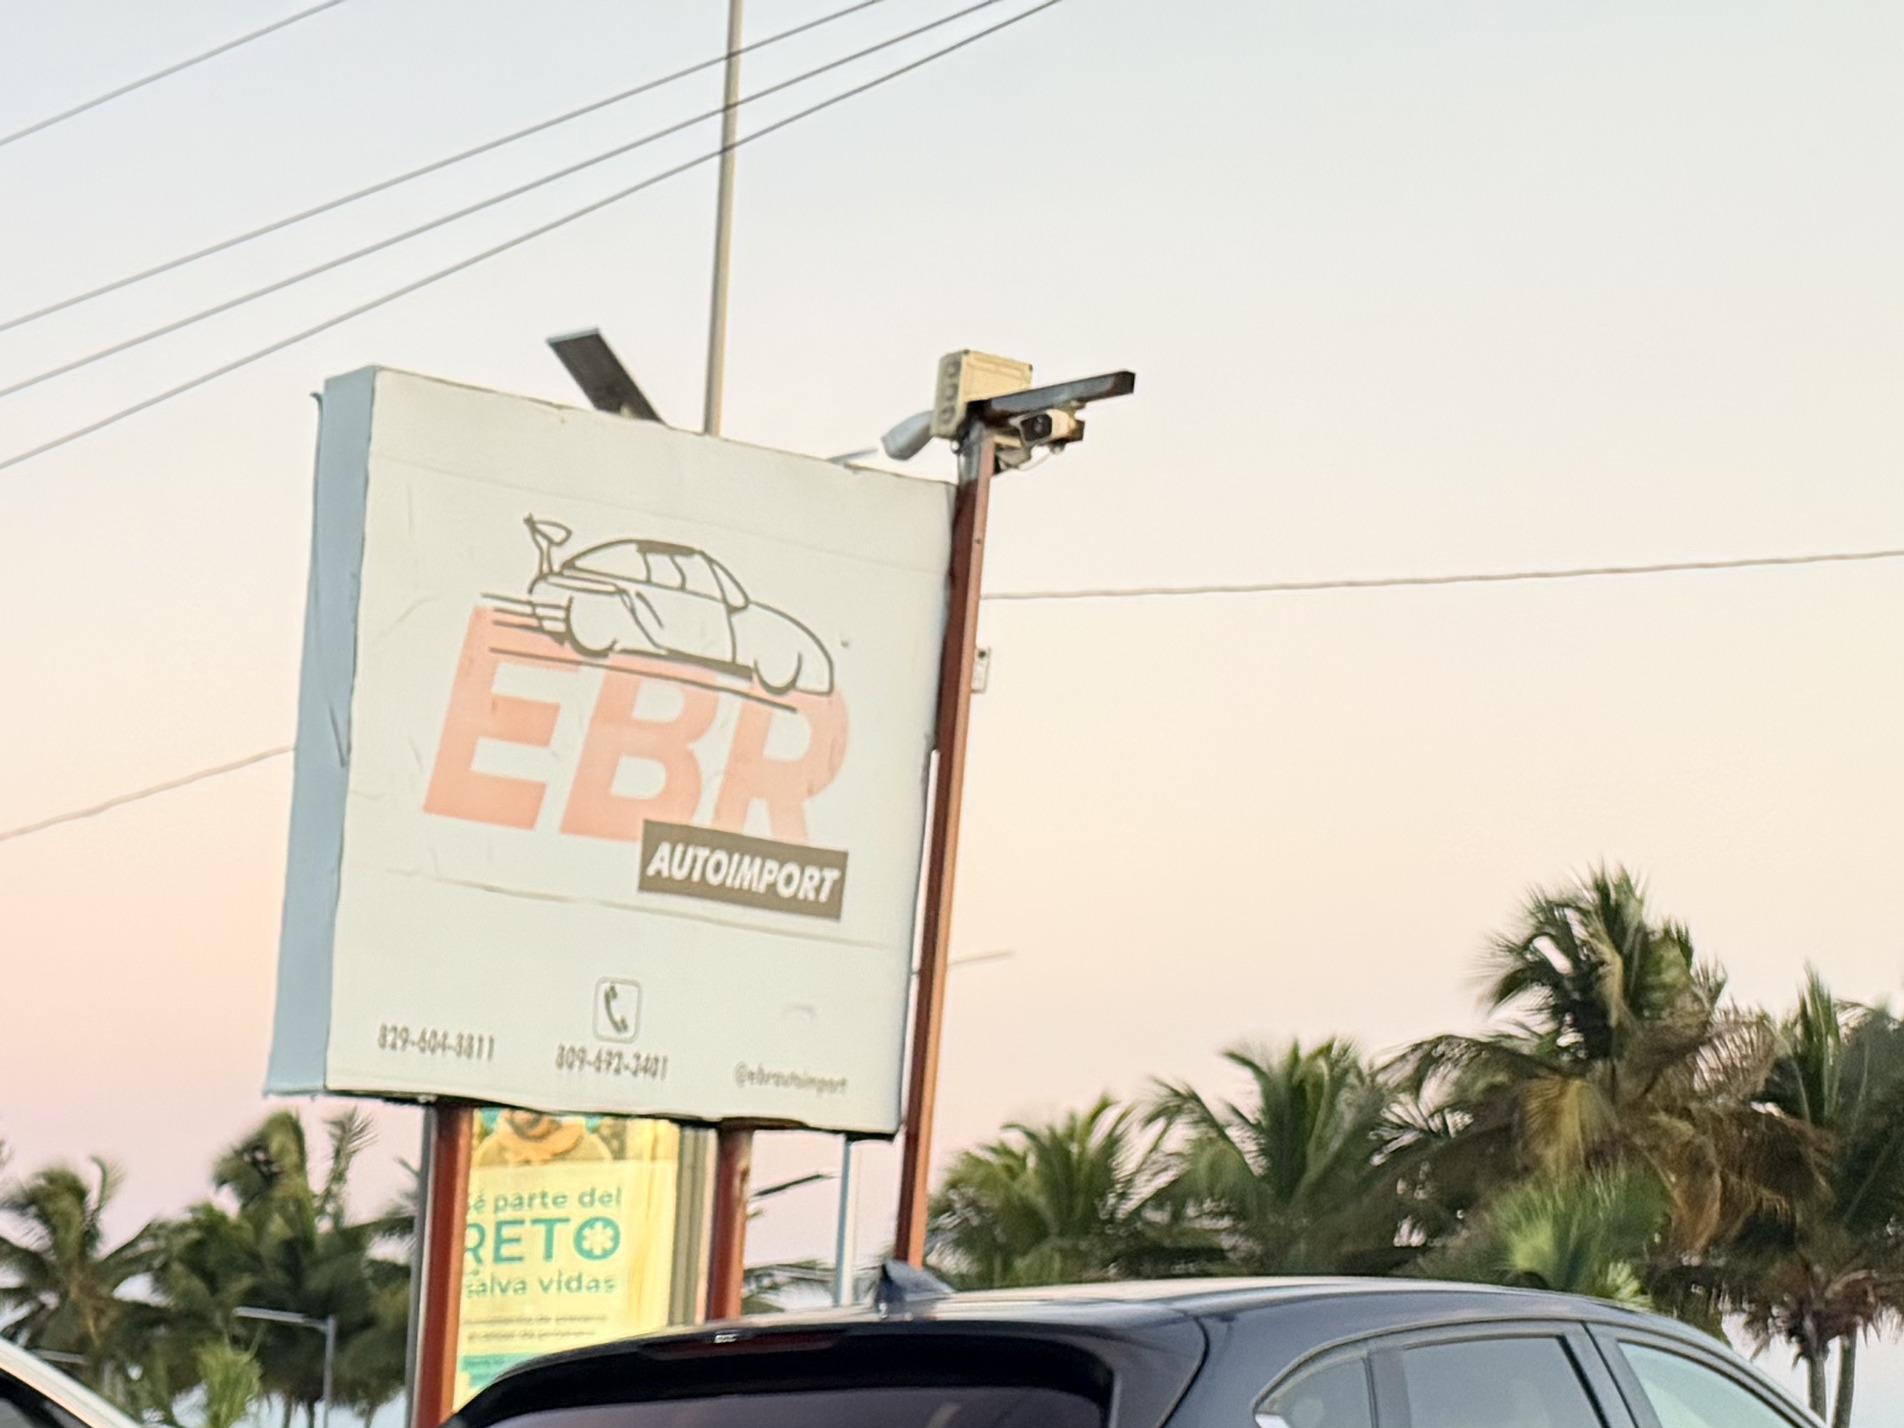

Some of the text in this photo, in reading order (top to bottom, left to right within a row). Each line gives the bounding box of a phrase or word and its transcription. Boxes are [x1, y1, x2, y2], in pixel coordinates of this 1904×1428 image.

[423, 605, 851, 845] EBR
[646, 841, 841, 903] AUTOIMPORT
[494, 1191, 568, 1214] parte
[578, 1186, 622, 1208] del
[465, 1216, 621, 1264] RETO
[538, 1269, 616, 1294] vidas
